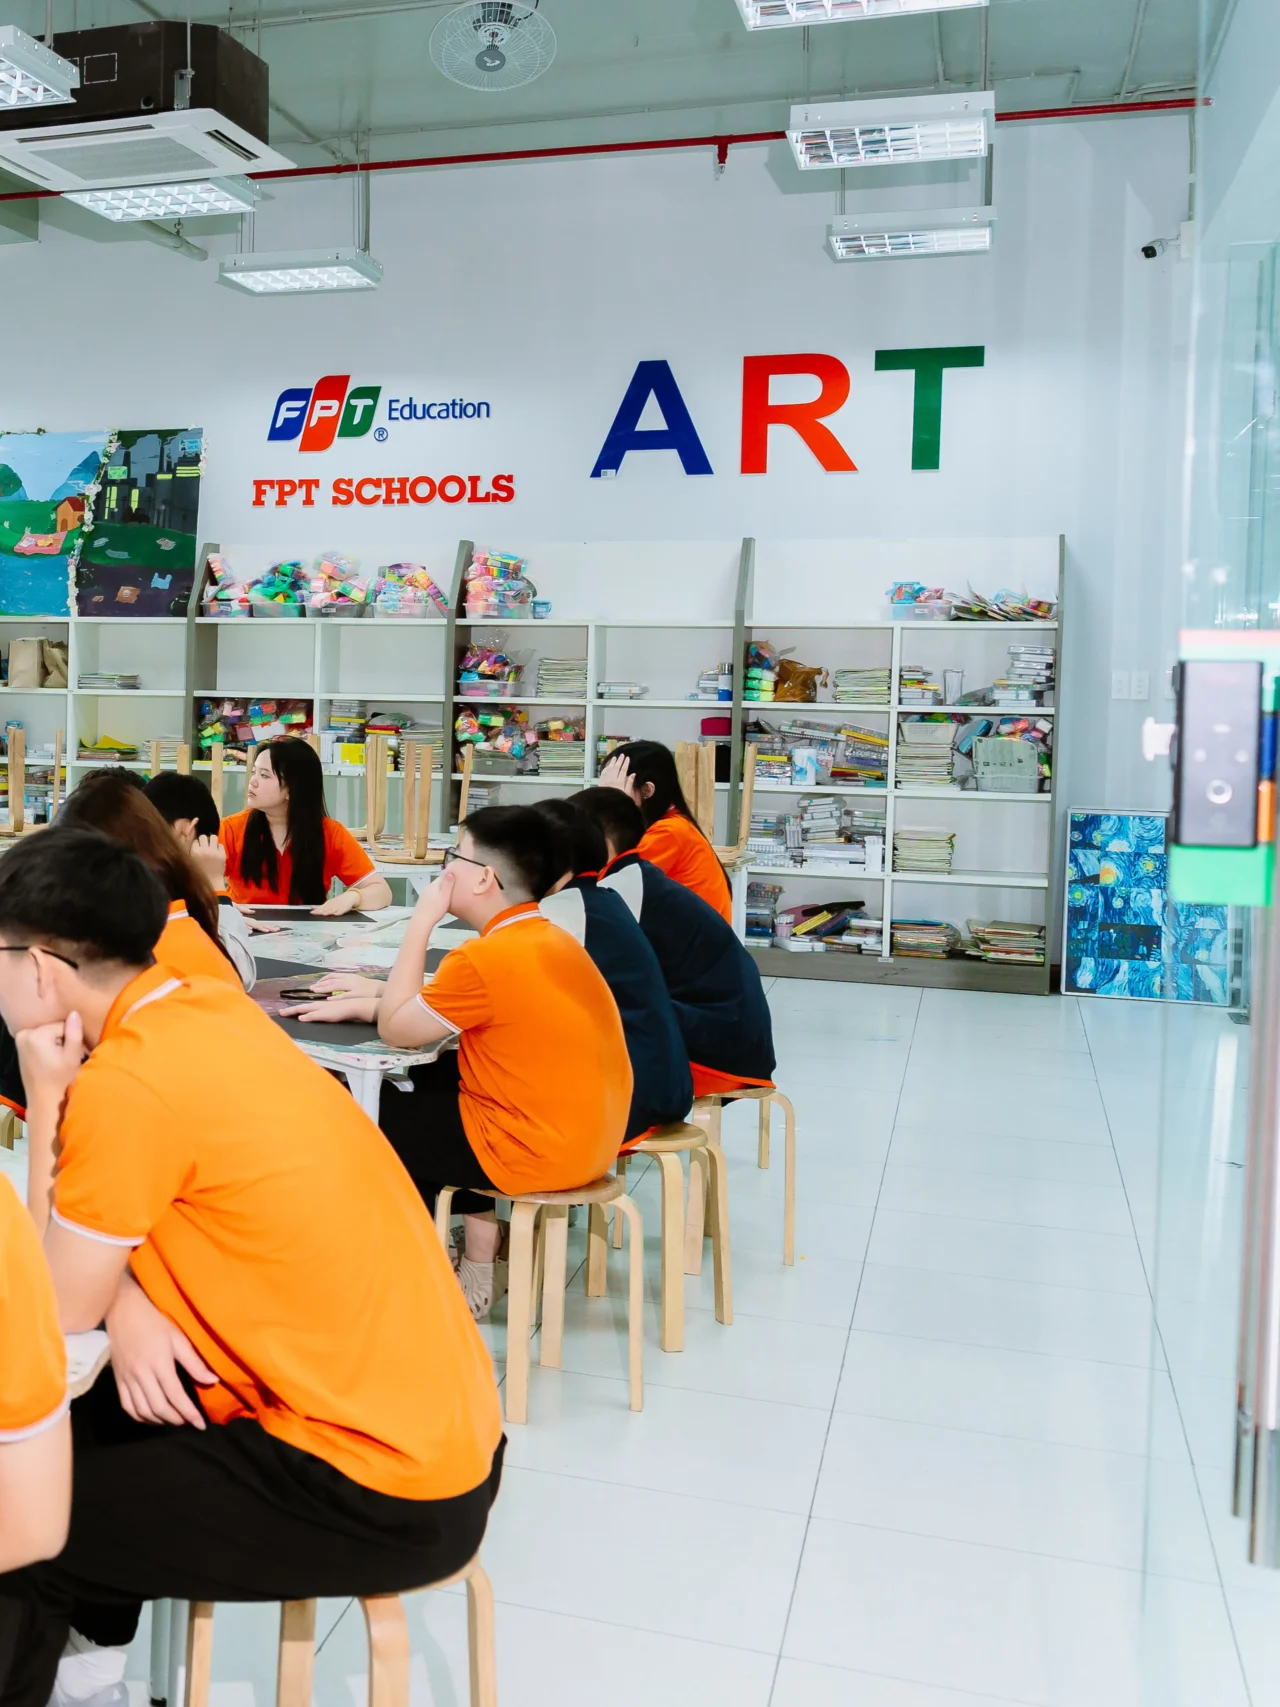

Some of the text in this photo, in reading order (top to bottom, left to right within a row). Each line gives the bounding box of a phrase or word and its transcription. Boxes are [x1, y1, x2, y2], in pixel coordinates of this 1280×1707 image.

[387, 397, 491, 421] Education
[590, 345, 985, 479] ART
[252, 474, 516, 507] FPT SCHOOLS
